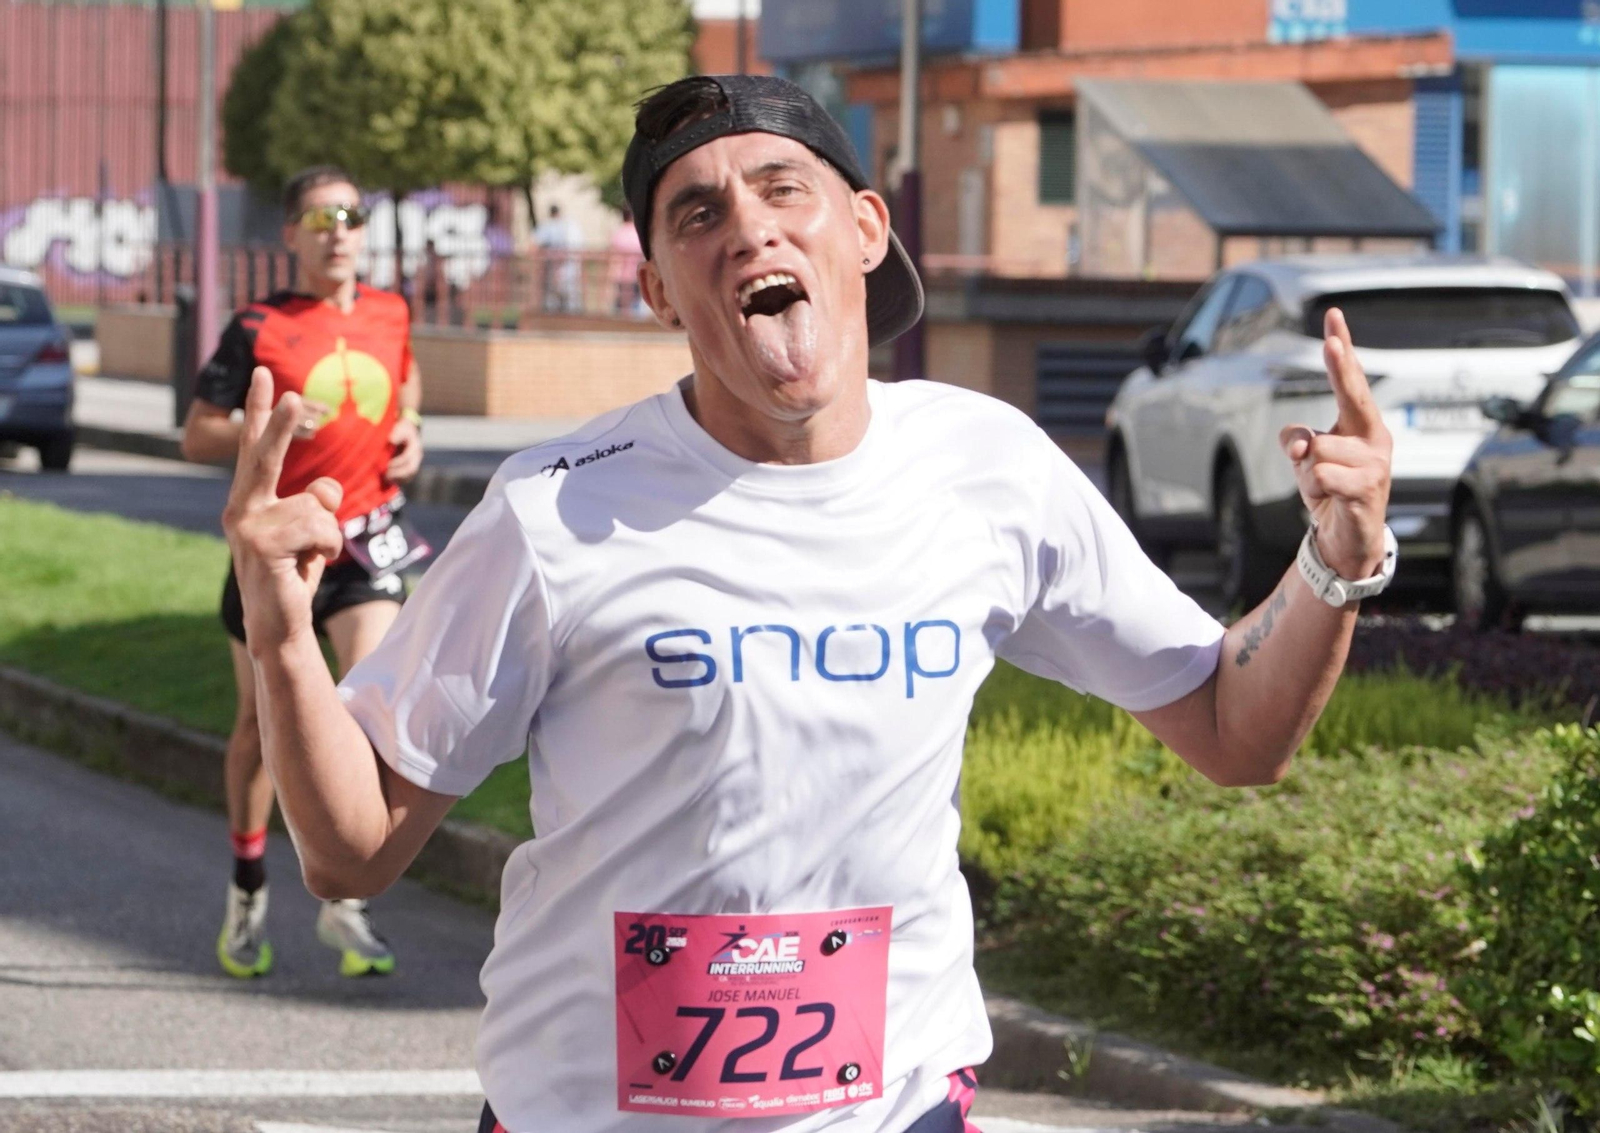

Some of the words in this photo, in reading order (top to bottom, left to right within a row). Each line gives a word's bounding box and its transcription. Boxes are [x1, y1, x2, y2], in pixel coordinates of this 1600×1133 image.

[574, 440, 634, 467] asioka
[645, 619, 961, 698] snop
[624, 923, 667, 954] 20
[731, 936, 800, 963] CAE
[708, 961, 804, 975] INTERRUNNING
[707, 990, 740, 1002] JOSE
[744, 987, 801, 1002] MANUEL
[670, 1002, 835, 1083] 722
